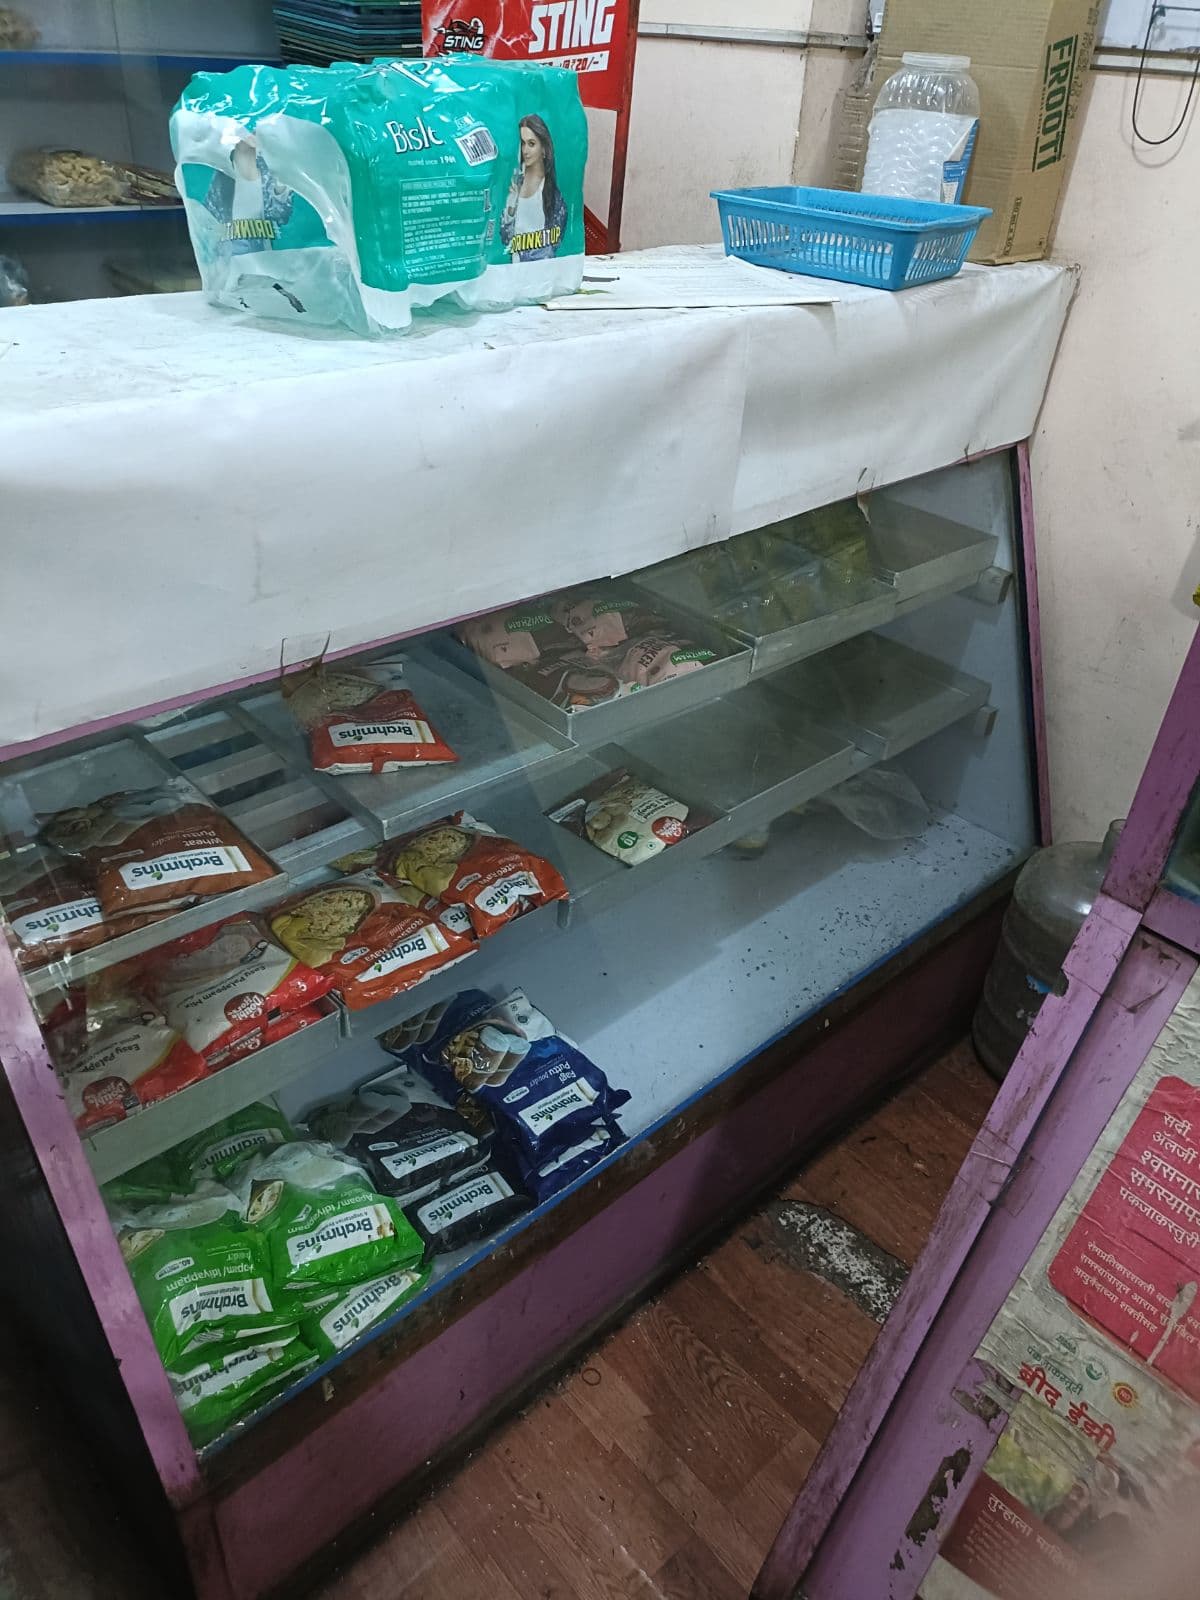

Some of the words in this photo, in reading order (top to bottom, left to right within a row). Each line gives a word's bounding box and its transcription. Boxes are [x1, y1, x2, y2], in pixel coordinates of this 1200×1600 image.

[528, 0, 616, 53] STING
[444, 36, 483, 49] STING
[1036, 36, 1076, 170] FROOTI
[338, 725, 414, 740] Brahmins
[622, 833, 637, 848] 10
[132, 855, 224, 878] Brahmins
[26, 906, 100, 930] ahmins
[552, 1061, 570, 1076] Puttu
[531, 1093, 582, 1122] Brahmins
[428, 1185, 493, 1221] Brahmins
[297, 1217, 373, 1253] Brahmins
[180, 1293, 248, 1319] Brahmins
[330, 1274, 403, 1334] Brahmins
[1131, 1292, 1158, 1315] आराम
[1017, 1361, 1062, 1408] ब्रीद
[987, 1493, 1033, 1536] तुम्हाला
